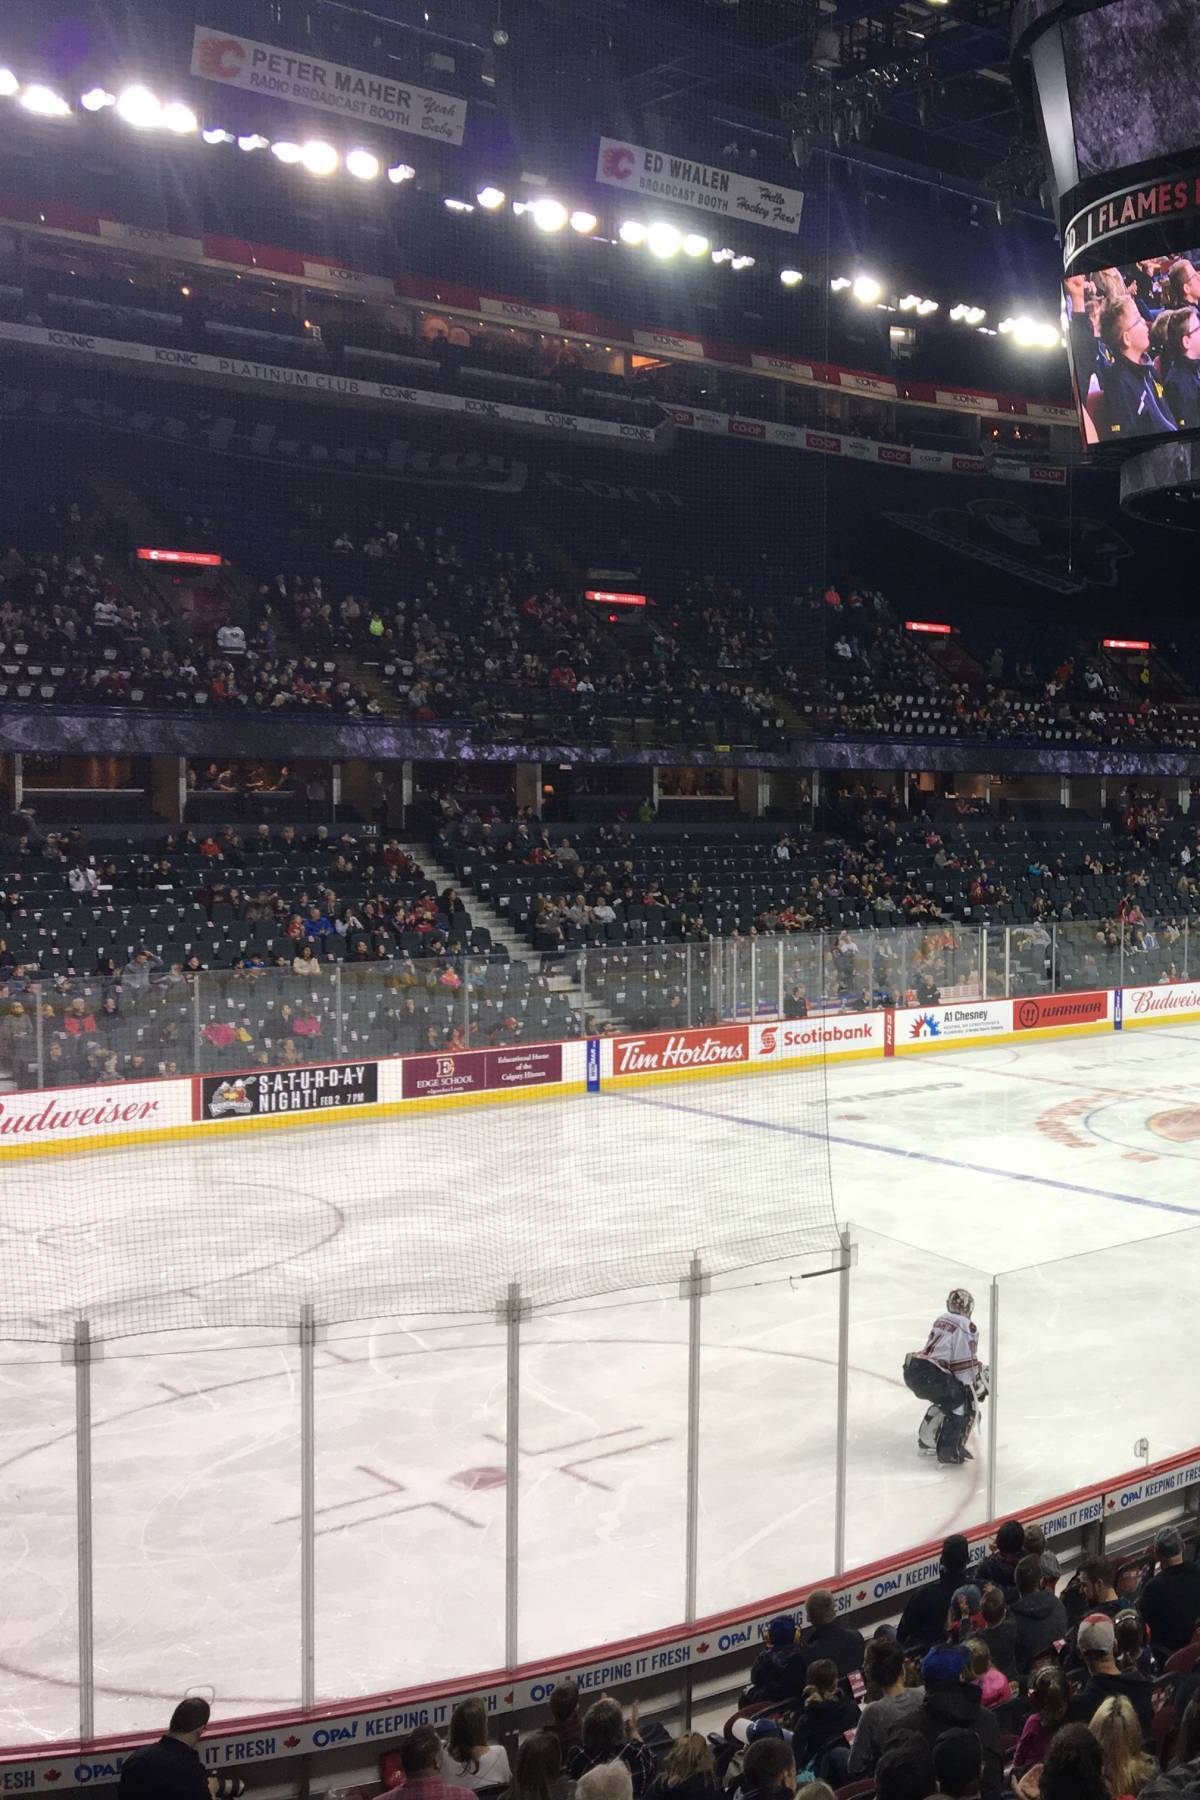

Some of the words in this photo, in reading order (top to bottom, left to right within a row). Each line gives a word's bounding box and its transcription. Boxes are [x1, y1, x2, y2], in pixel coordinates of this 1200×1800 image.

[252, 48, 326, 86] PETER
[334, 71, 412, 109] MAHER
[250, 72, 290, 93] RADIO
[292, 83, 367, 114] BROADCAST
[369, 103, 410, 126] BOOTH
[643, 152, 663, 173] ED
[670, 160, 730, 193] WHALEN
[639, 176, 695, 202] BROADCAST
[698, 193, 729, 212] BOOTH
[736, 196, 769, 219] Hockey
[1098, 180, 1188, 233] FLAMES
[48, 331, 95, 350] ICONIC
[155, 347, 199, 366] ICONIC
[219, 360, 309, 386] PLATINUM
[315, 375, 360, 394] CLUB
[379, 385, 417, 401] ICONIC
[620, 425, 653, 440] ICONIC
[944, 1011, 953, 1022] A1
[954, 1010, 988, 1021] Chesney
[1042, 1002, 1102, 1018] WARRIOR
[784, 1023, 872, 1047] Scotiabank
[498, 1054, 529, 1064] Educational
[531, 1053, 550, 1061] Home
[617, 1040, 658, 1071] Tim
[662, 1036, 744, 1067] Hortons
[259, 1066, 365, 1093] S-A-T-U-R-D-A-Y
[417, 1078, 438, 1089] EDGE
[440, 1075, 474, 1086] SCHOOL
[501, 1072, 523, 1082] Calgary
[524, 1071, 546, 1079] Hitmen
[259, 1089, 317, 1113] NIGHT!
[320, 1097, 333, 1106] FEB
[335, 1095, 340, 1105] 2
[353, 1093, 364, 1103] PM
[1120, 1486, 1142, 1507] OPA!
[1145, 1475, 1175, 1496] KEEPING
[1177, 1472, 1184, 1486] IT
[1041, 1514, 1067, 1536] EEPING
[1069, 1512, 1078, 1526] IT
[874, 1574, 902, 1599] OPA!
[970, 1545, 986, 1562] ESH
[718, 1625, 752, 1651] OPA!
[577, 1661, 632, 1689] KEEPING
[636, 1657, 647, 1675] IT
[652, 1646, 691, 1671] FRESH
[313, 1721, 358, 1747] OPA!
[366, 1710, 429, 1737] KEEPING
[434, 1705, 448, 1723] IT
[4, 1770, 35, 1790] ESH
[205, 1746, 220, 1764] IT
[225, 1738, 276, 1761] FRESH
